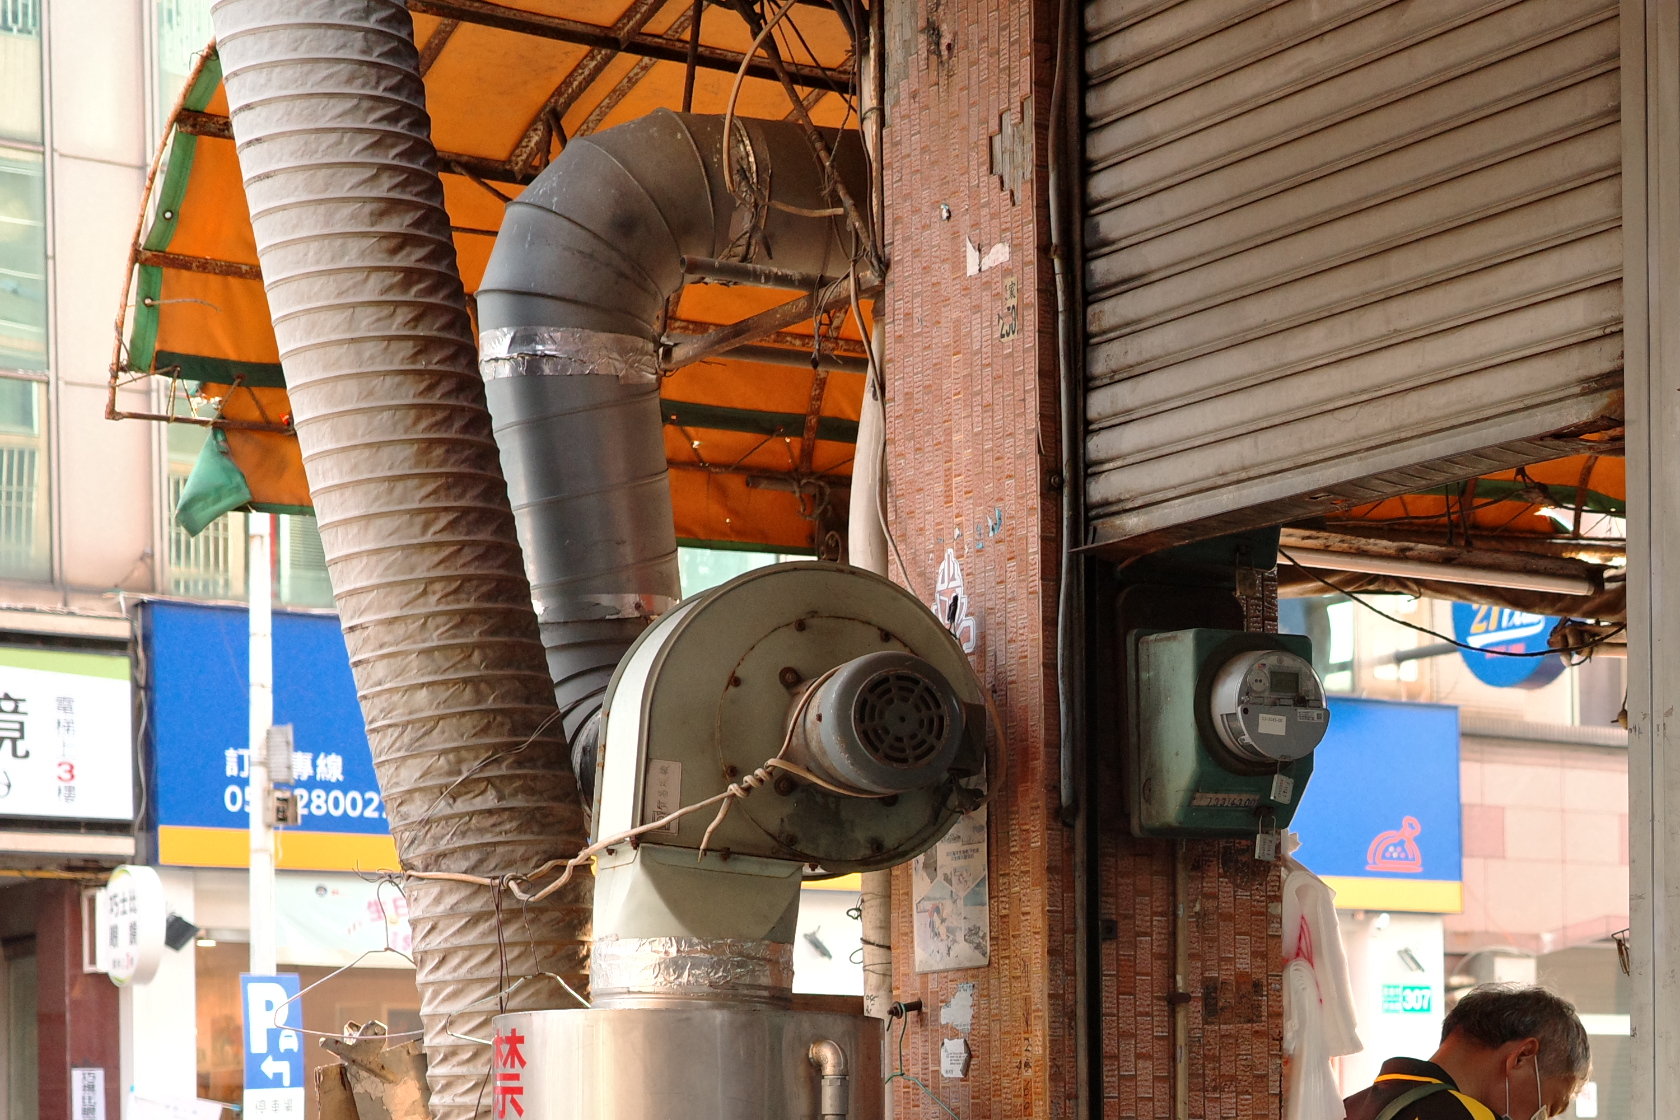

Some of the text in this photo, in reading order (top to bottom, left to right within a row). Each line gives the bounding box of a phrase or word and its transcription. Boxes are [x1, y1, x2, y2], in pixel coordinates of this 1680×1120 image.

[224, 747, 344, 782] 訂專線
[1403, 988, 1430, 1010] 307
[247, 982, 288, 1053] P
